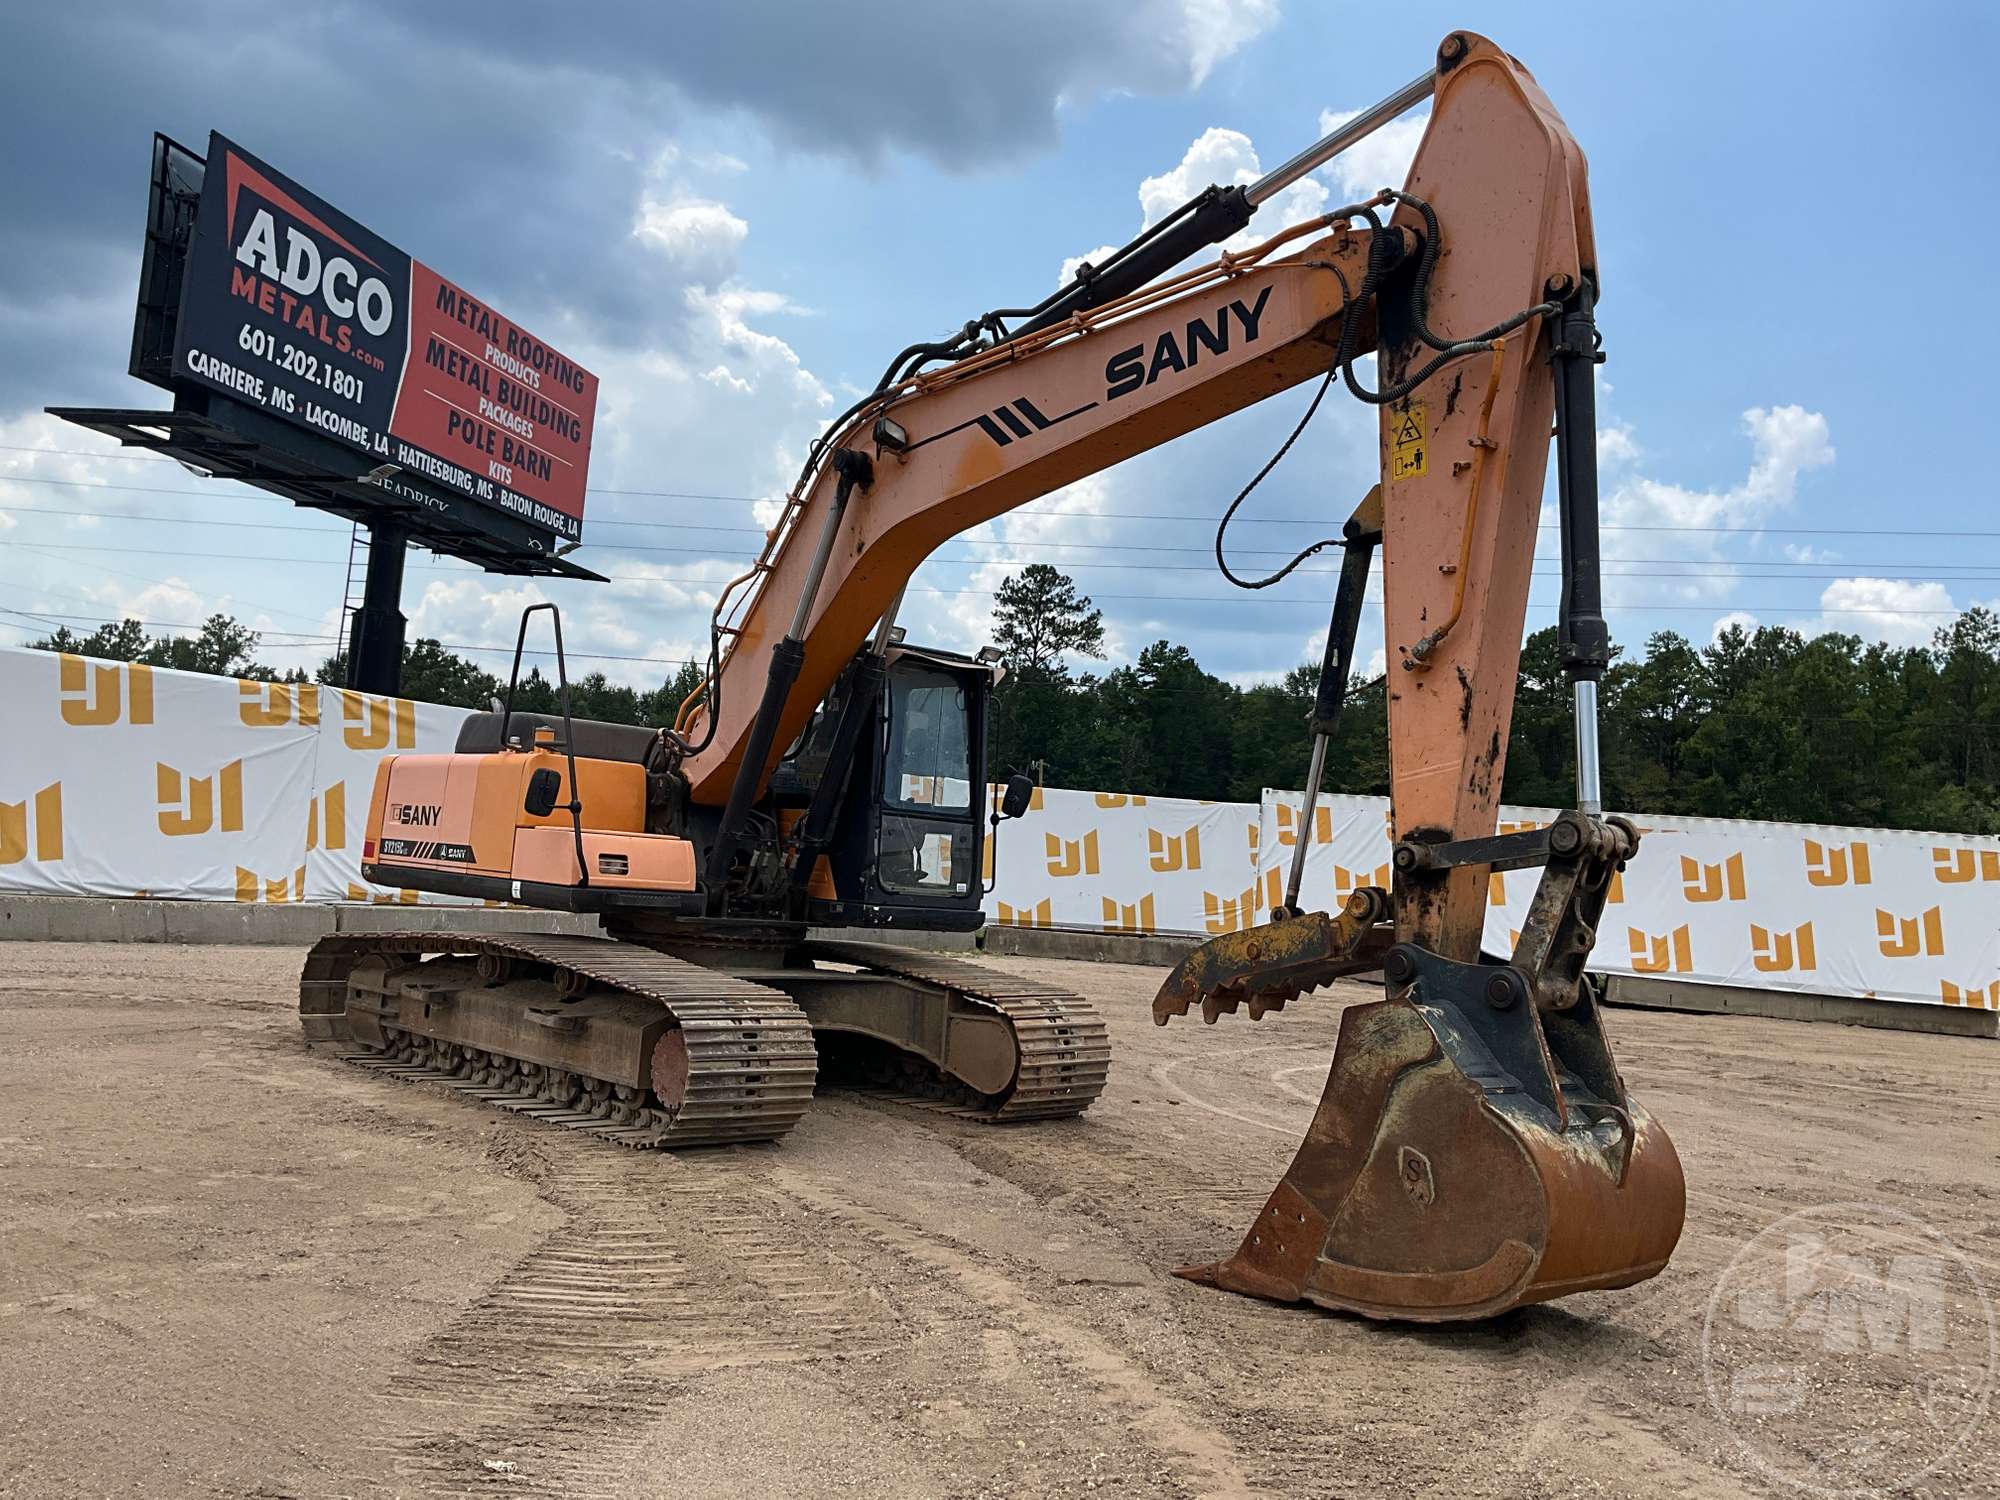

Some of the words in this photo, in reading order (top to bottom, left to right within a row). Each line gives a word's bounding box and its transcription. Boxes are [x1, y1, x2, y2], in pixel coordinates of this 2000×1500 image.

[236, 208, 393, 336] ADCO
[238, 323, 365, 405] 601.202.1801
[436, 284, 500, 345] METAL
[506, 327, 585, 394] ROOFING
[485, 343, 541, 389] PRODUCTS
[1105, 284, 1274, 402] SANY
[425, 338, 490, 396] METAL
[497, 377, 581, 444] BUILDING
[479, 396, 534, 440] PACKAGES
[187, 349, 268, 406] CARRIERE,
[270, 386, 296, 415] MS
[305, 401, 371, 451] LACOMBE,
[374, 432, 390, 456] LA
[398, 444, 475, 497] HATTIESBURG,
[476, 482, 494, 501] MS
[500, 488, 537, 517] BATON
[533, 510, 566, 535] ROUGE,
[567, 518, 579, 537] LA
[448, 410, 497, 456] POLE
[502, 437, 552, 482] BARN
[488, 460, 513, 485] KITS
[401, 804, 442, 826] SANY
[448, 849, 466, 859] SANY
